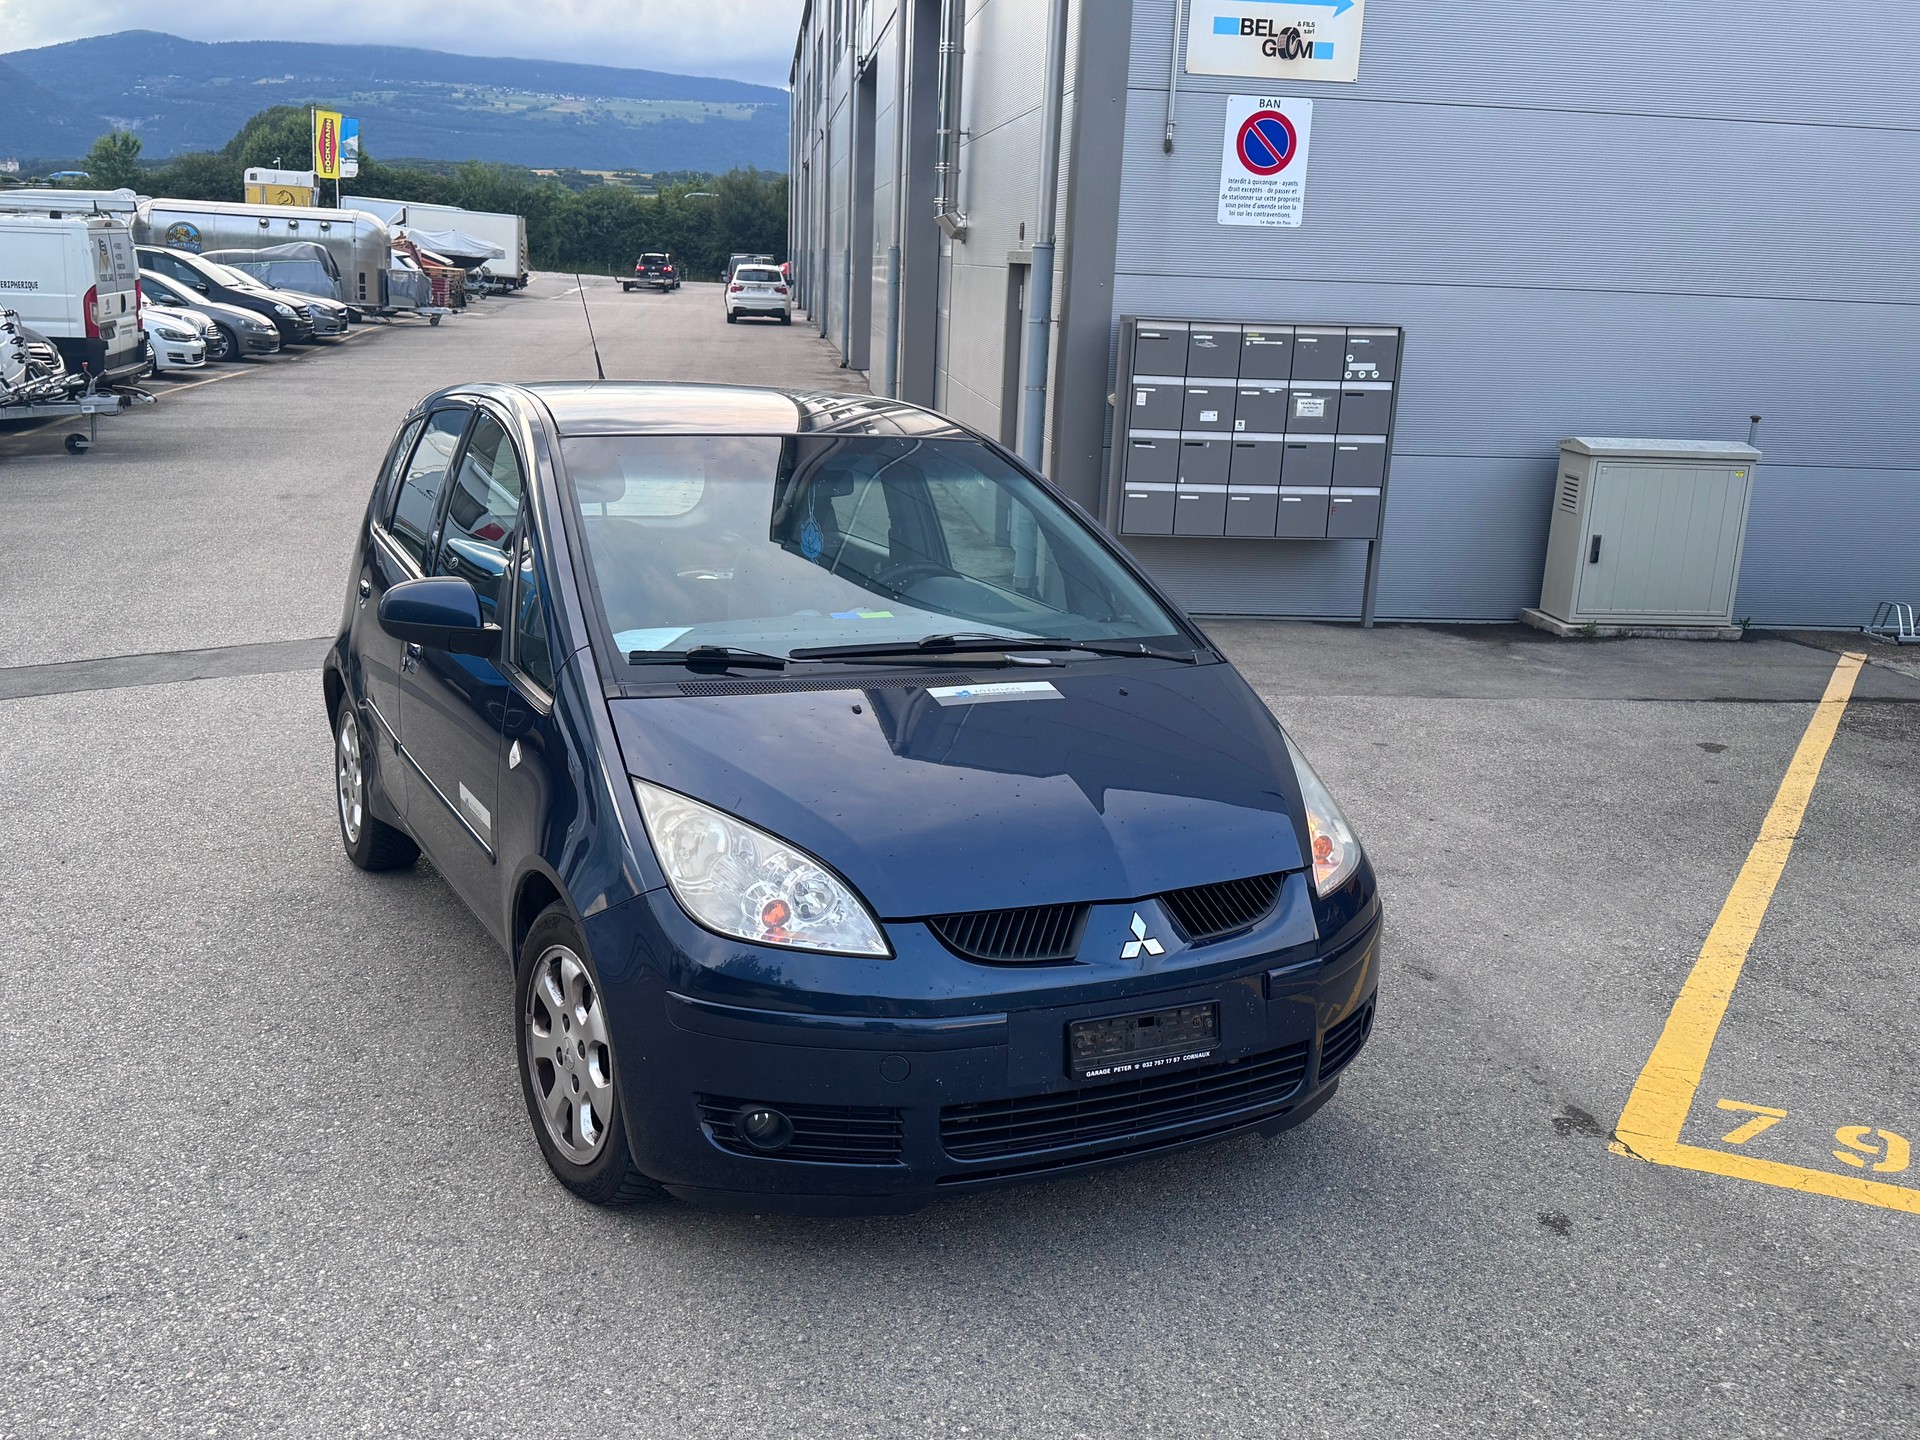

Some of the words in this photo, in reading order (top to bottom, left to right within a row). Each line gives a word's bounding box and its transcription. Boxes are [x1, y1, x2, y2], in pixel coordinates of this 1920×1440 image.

[1240, 17, 1279, 37] BEL
[1259, 98, 1281, 109] BAN
[1252, 179, 1278, 187] quiconque
[1086, 1068, 1111, 1078] GARAGE
[1113, 1065, 1132, 1073] PETER
[1182, 1051, 1211, 1061] CORNAUX
